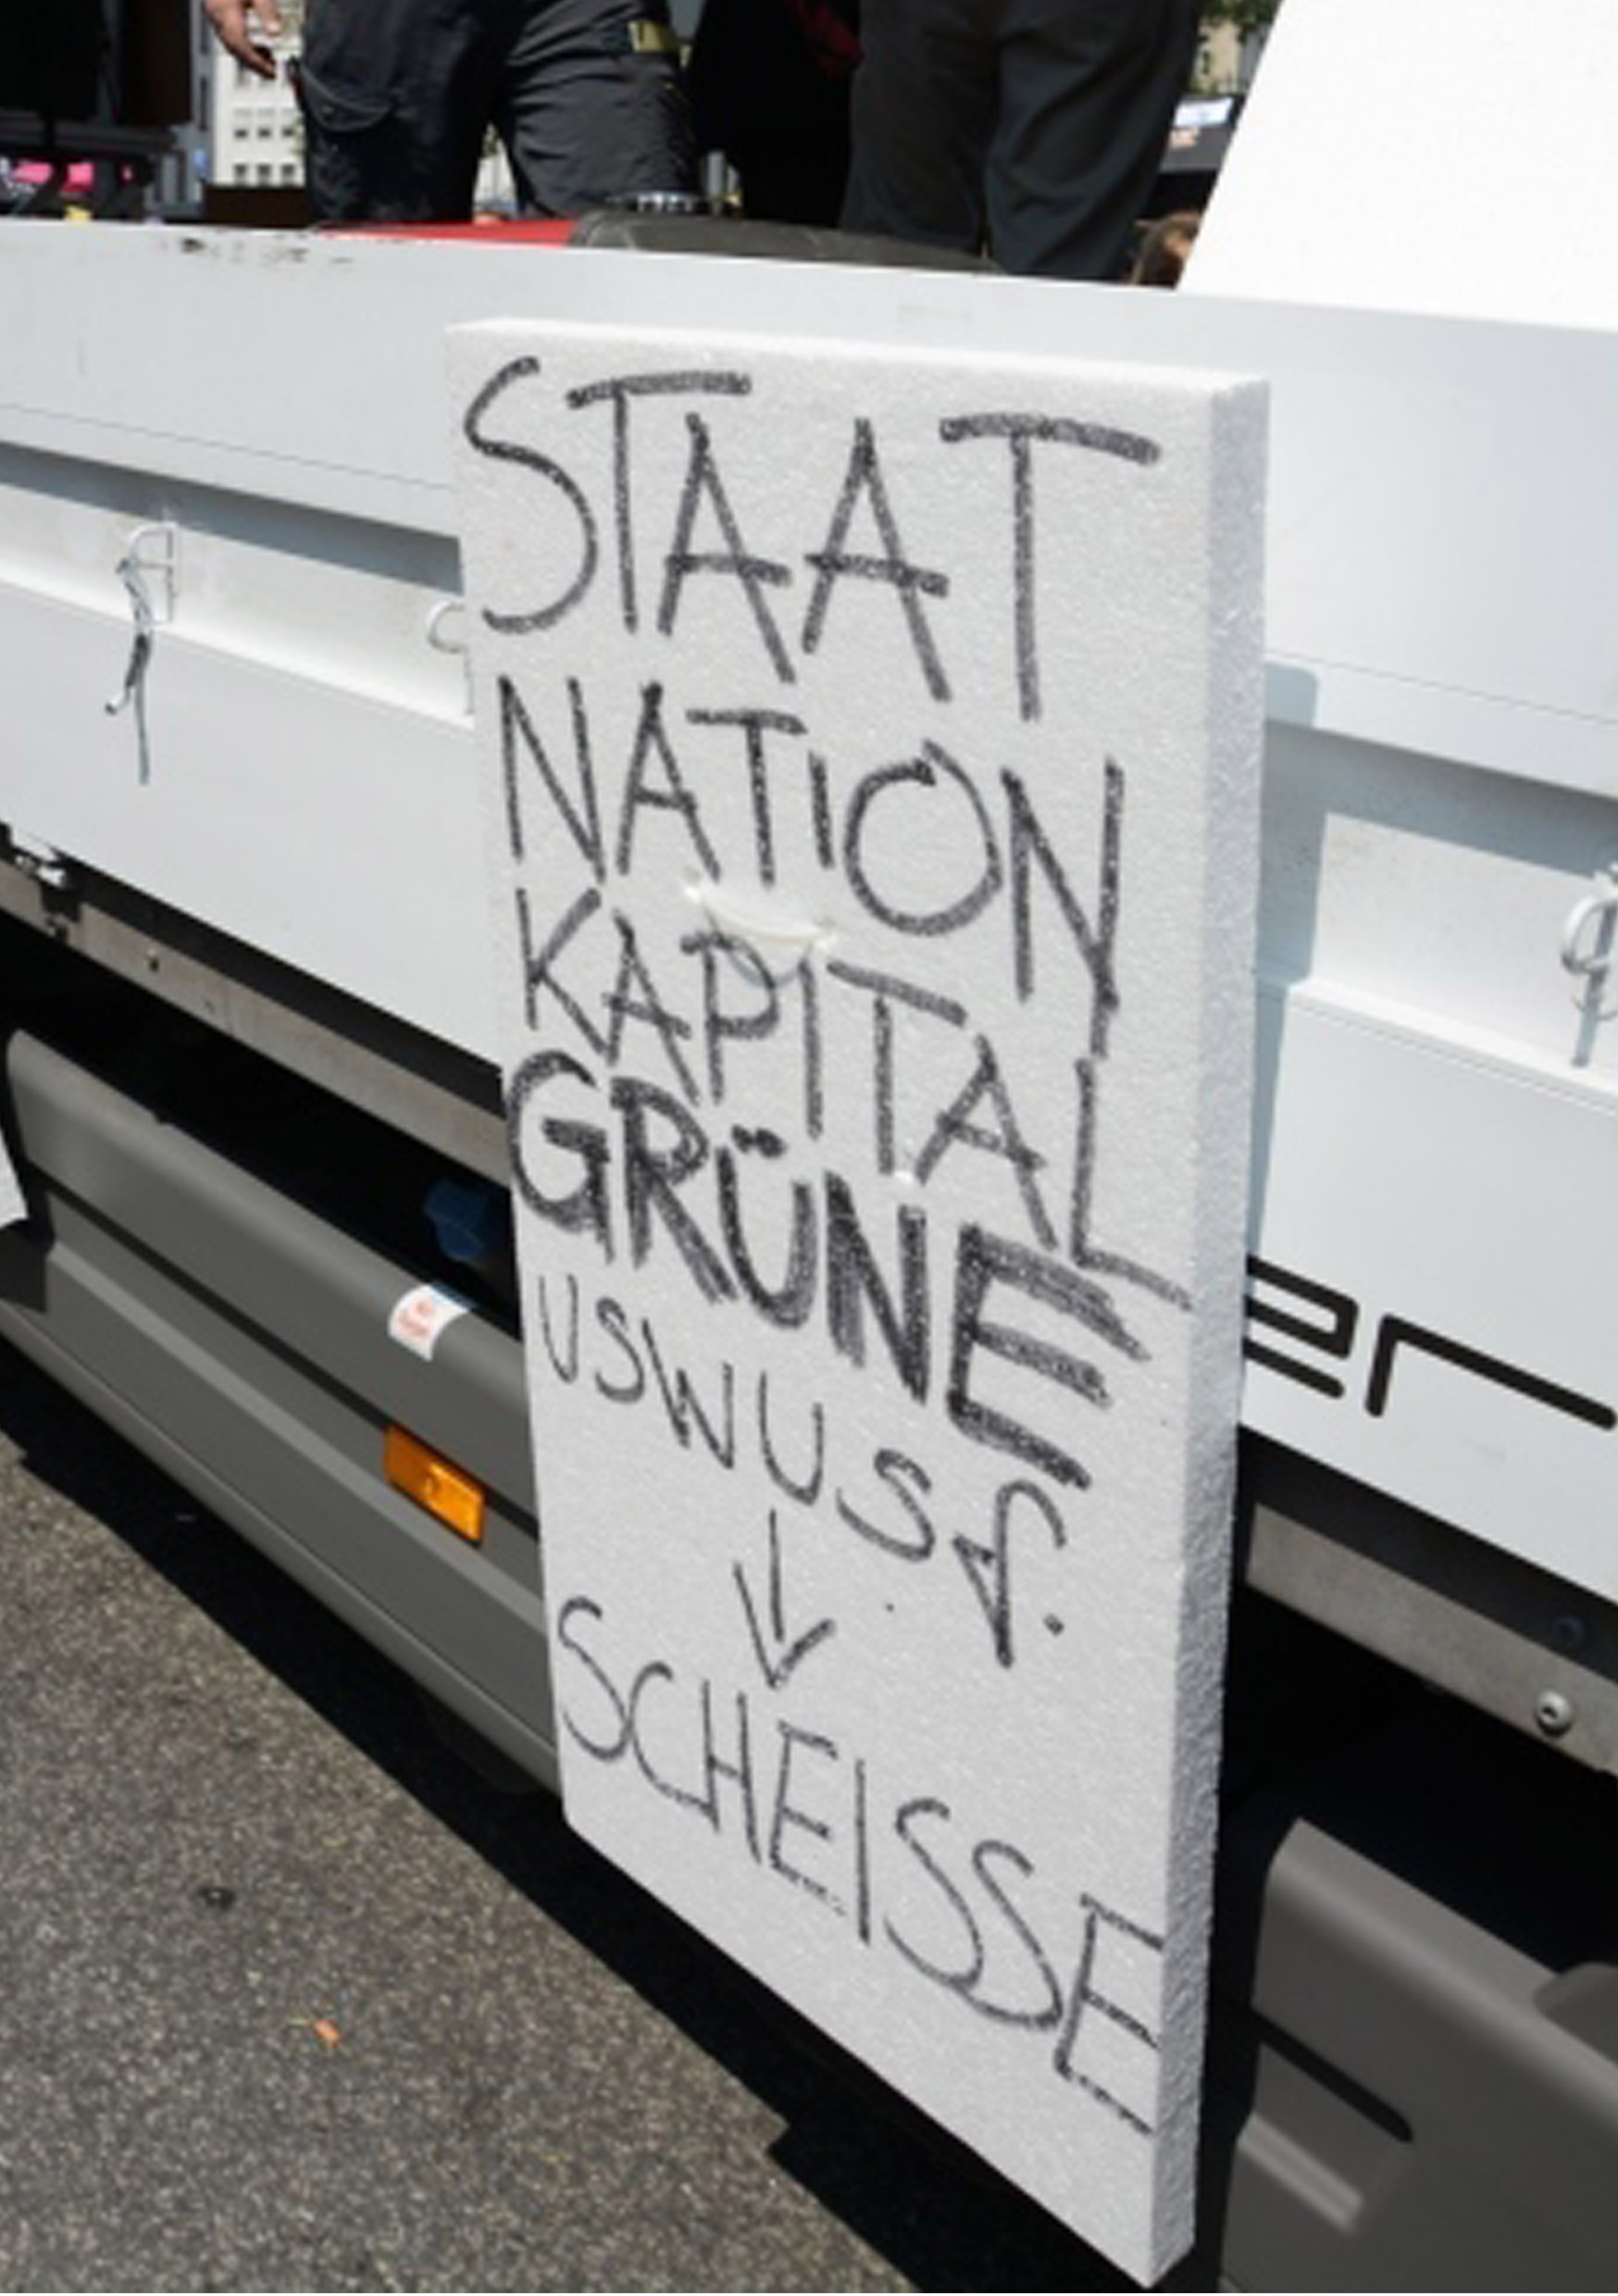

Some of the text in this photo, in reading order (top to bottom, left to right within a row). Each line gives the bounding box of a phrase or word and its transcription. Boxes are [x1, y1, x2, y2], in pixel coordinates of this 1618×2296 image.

[465, 356, 1162, 722] STAAT
[498, 673, 1125, 1013] NATION
[508, 1050, 1151, 1490] GRÜNE
[514, 886, 1193, 1313] KAPITAL
[557, 1596, 1164, 2136] SCHEISSE
